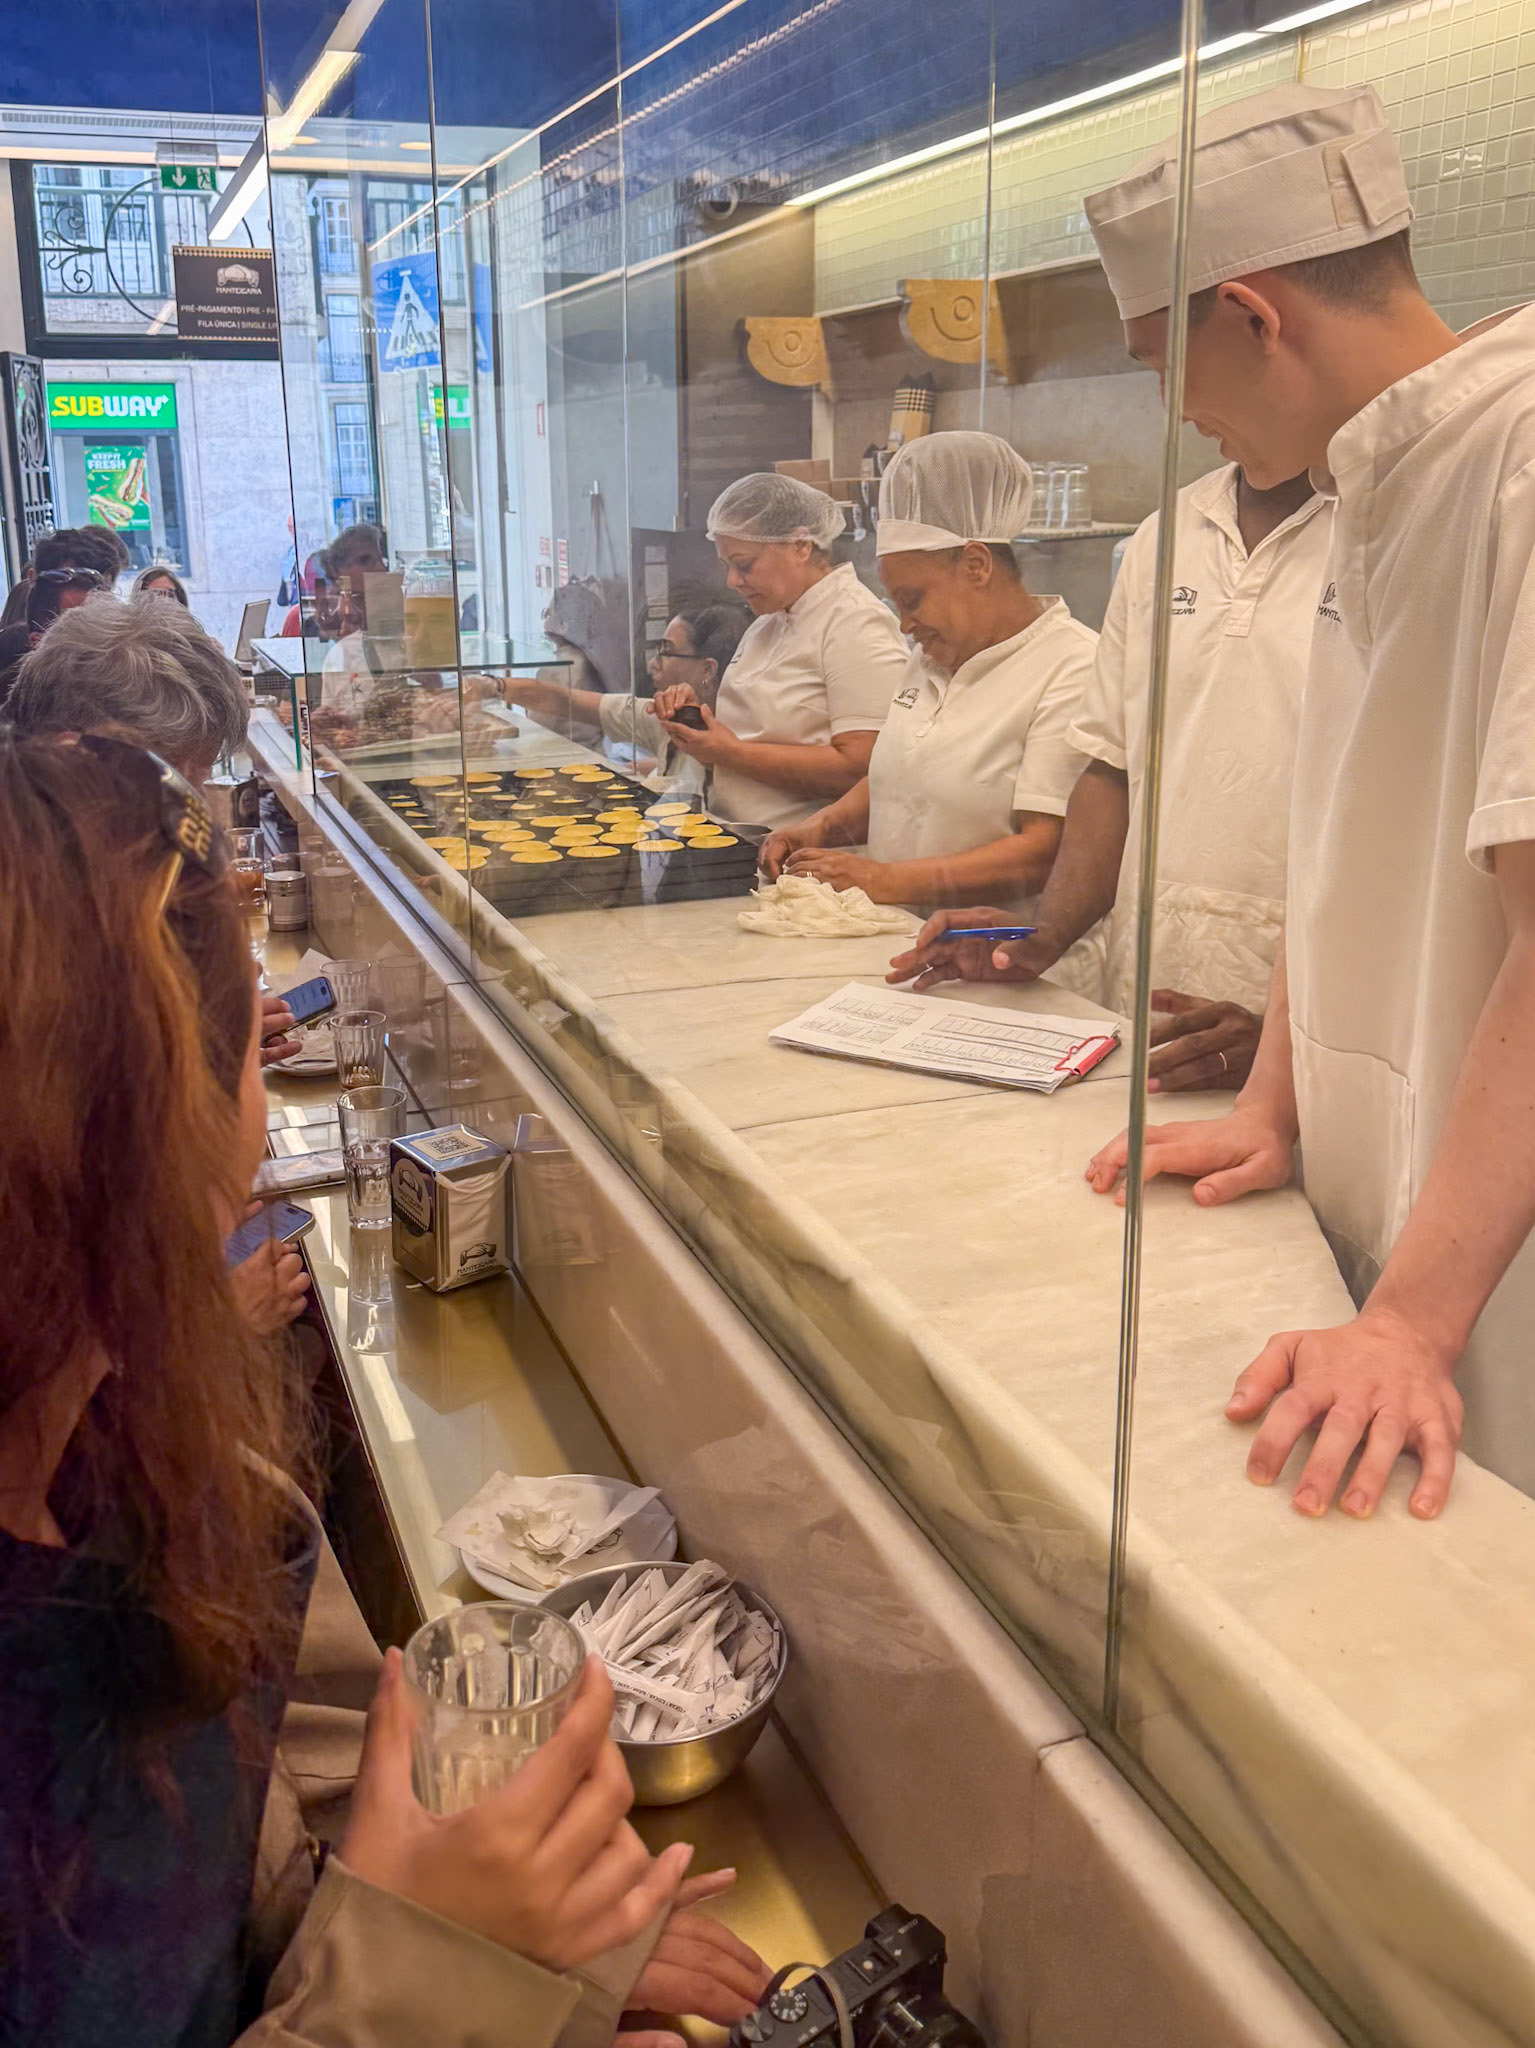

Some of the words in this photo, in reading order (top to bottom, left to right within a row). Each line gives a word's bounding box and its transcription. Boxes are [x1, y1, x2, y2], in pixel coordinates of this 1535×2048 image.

[180, 304, 242, 314] PRÉ-PAGAMENTO
[197, 319, 214, 328] FILA
[214, 319, 237, 329] ÚNICA
[51, 395, 169, 417] SUBWAY
[87, 459, 127, 470] FRESH
